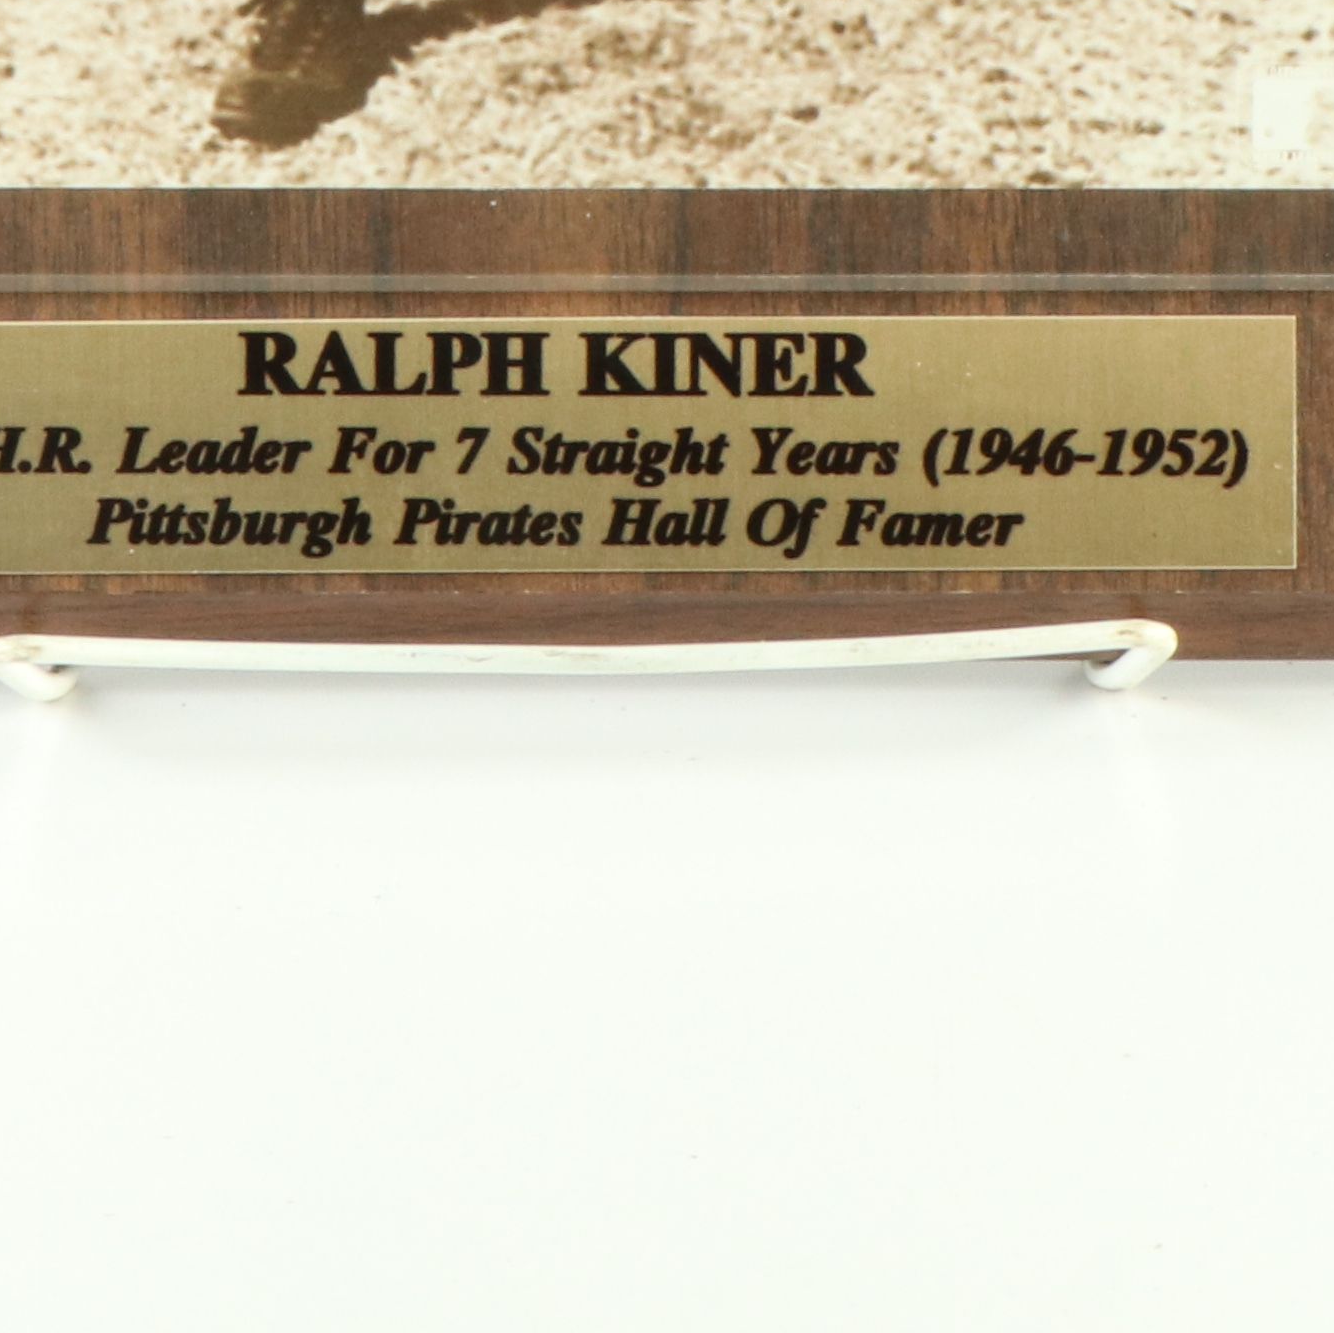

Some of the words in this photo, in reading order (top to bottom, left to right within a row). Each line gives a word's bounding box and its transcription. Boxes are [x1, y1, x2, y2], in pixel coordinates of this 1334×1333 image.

[237, 330, 550, 397] RALPH
[578, 331, 875, 398] KINER
[114, 424, 313, 475] Leader
[327, 425, 436, 475] For
[455, 425, 490, 475] 7
[505, 425, 730, 488] Straight
[750, 426, 900, 476] Years
[921, 426, 1250, 489] (1946-1952)
[85, 495, 373, 559] Pittsburgh
[392, 496, 583, 547] Pirates
[600, 496, 730, 547] Hall
[744, 496, 831, 560] Of
[837, 497, 1025, 548] Famer
